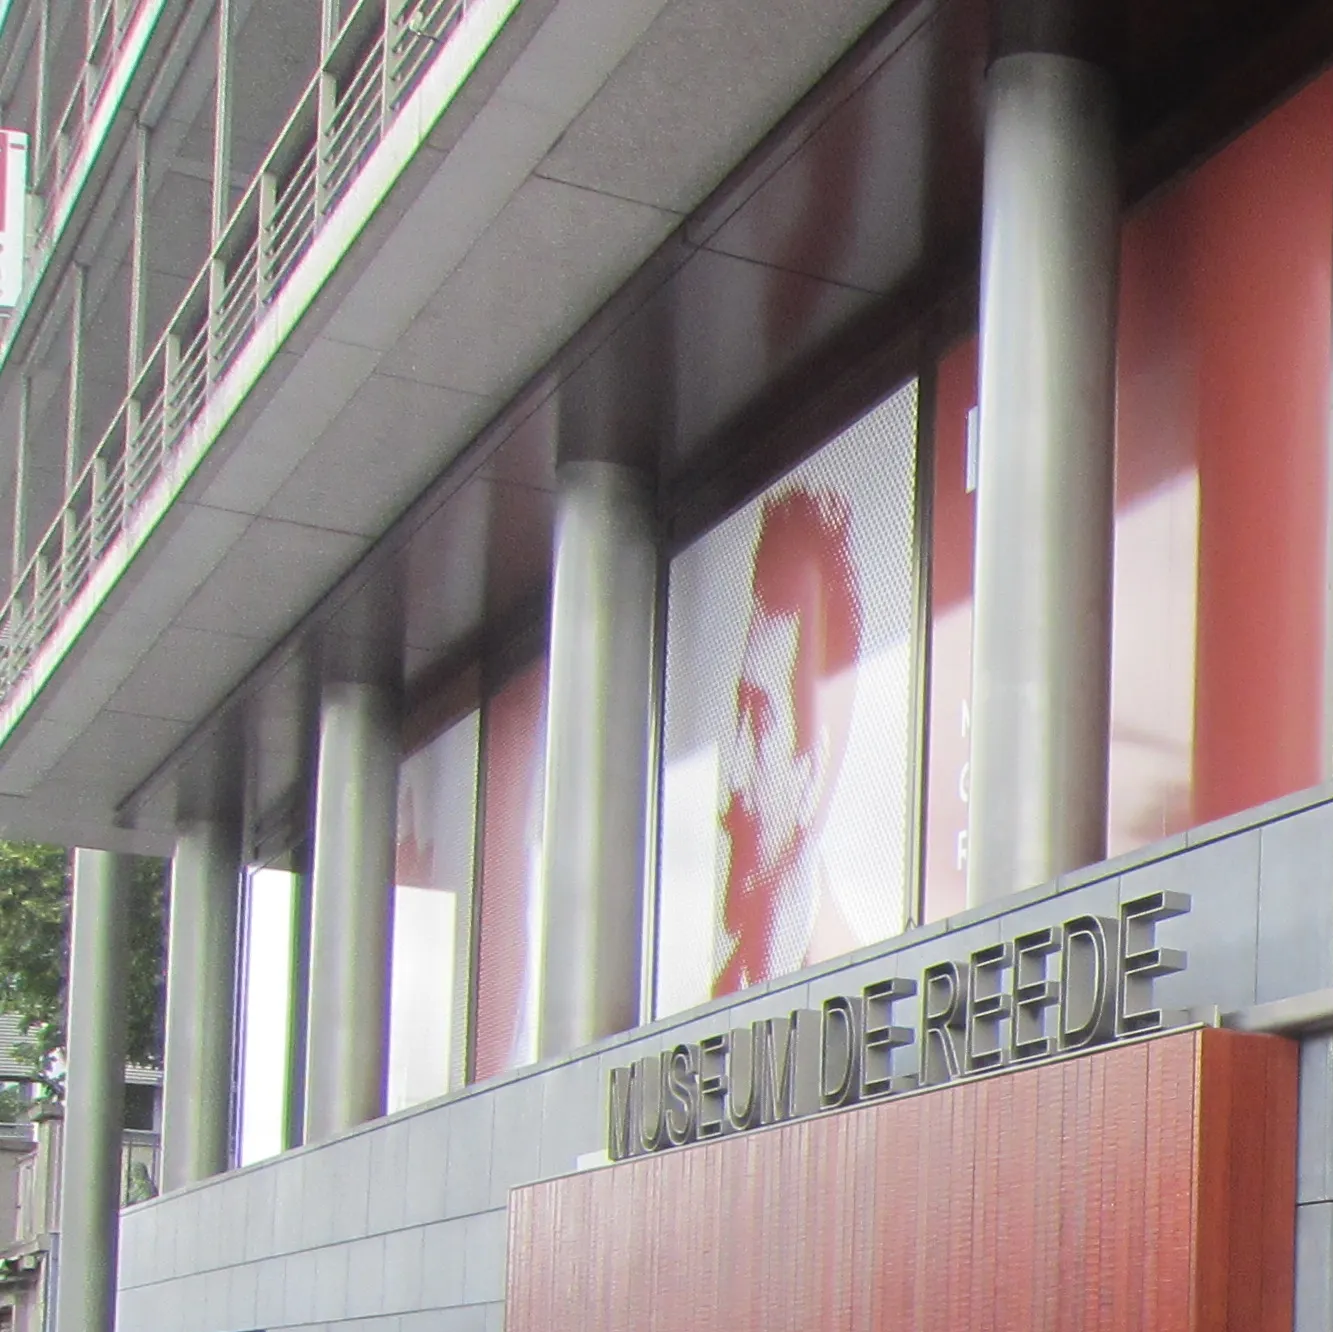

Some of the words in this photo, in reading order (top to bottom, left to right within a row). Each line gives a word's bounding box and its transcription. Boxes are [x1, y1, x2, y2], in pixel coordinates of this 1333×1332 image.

[607, 1009, 818, 1161] MUSEUM
[820, 977, 916, 1110] DE
[919, 890, 1191, 1086] REEDE
